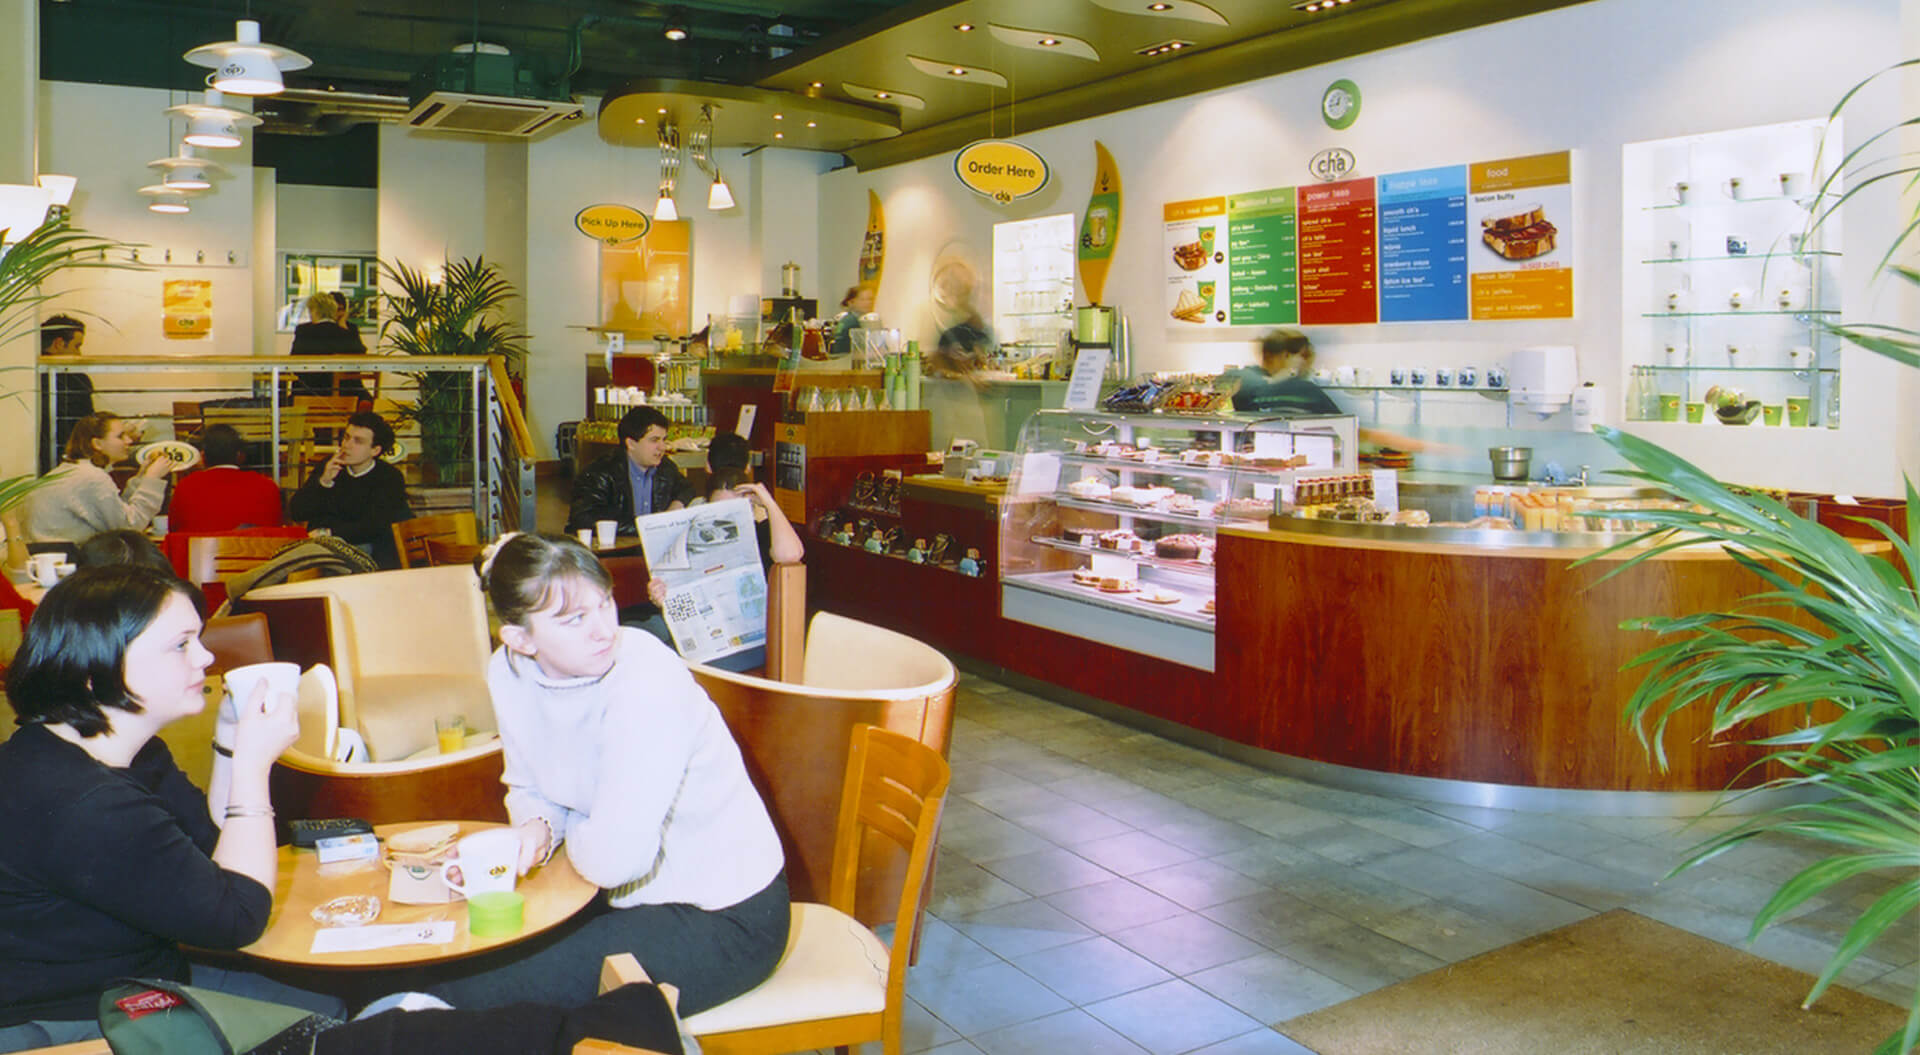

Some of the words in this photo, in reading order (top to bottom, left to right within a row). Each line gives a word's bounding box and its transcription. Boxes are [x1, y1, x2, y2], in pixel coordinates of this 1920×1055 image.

[968, 161, 1004, 175] Order
[1007, 164, 1036, 178] Here
[1486, 168, 1509, 178] food
[1306, 191, 1330, 202] power
[581, 216, 601, 225] Pick
[604, 218, 619, 228] Up
[621, 219, 645, 229] Here
